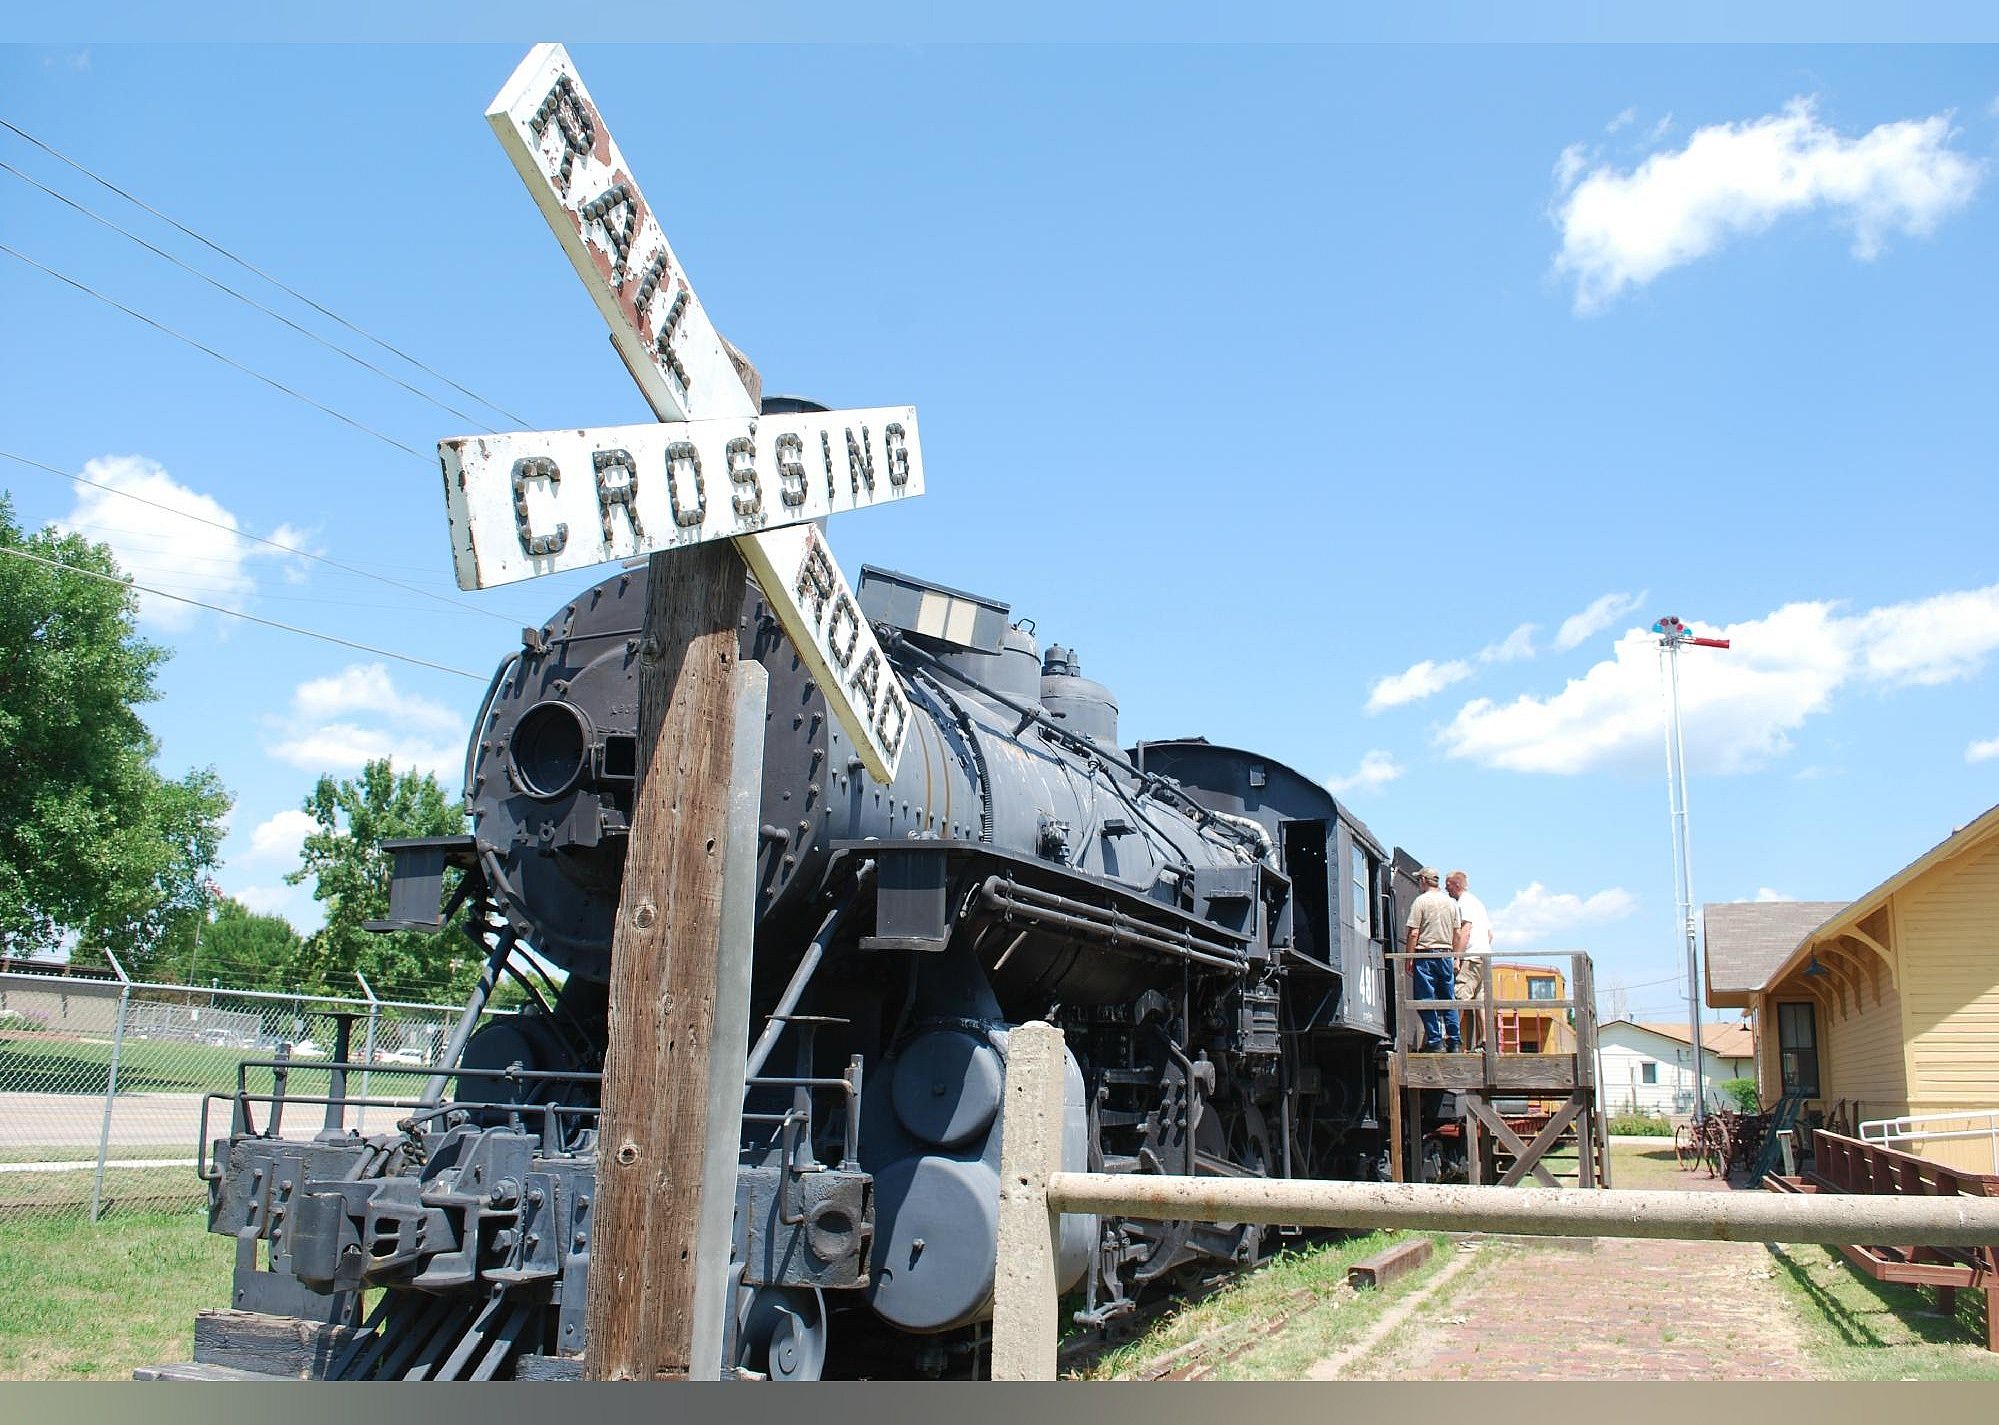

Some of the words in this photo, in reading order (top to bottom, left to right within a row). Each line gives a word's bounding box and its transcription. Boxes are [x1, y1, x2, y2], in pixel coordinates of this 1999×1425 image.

[529, 72, 690, 391] RAIL
[798, 537, 906, 758] ROAD
[511, 423, 910, 556] CROSSING
[1360, 963, 1375, 1007] 481
